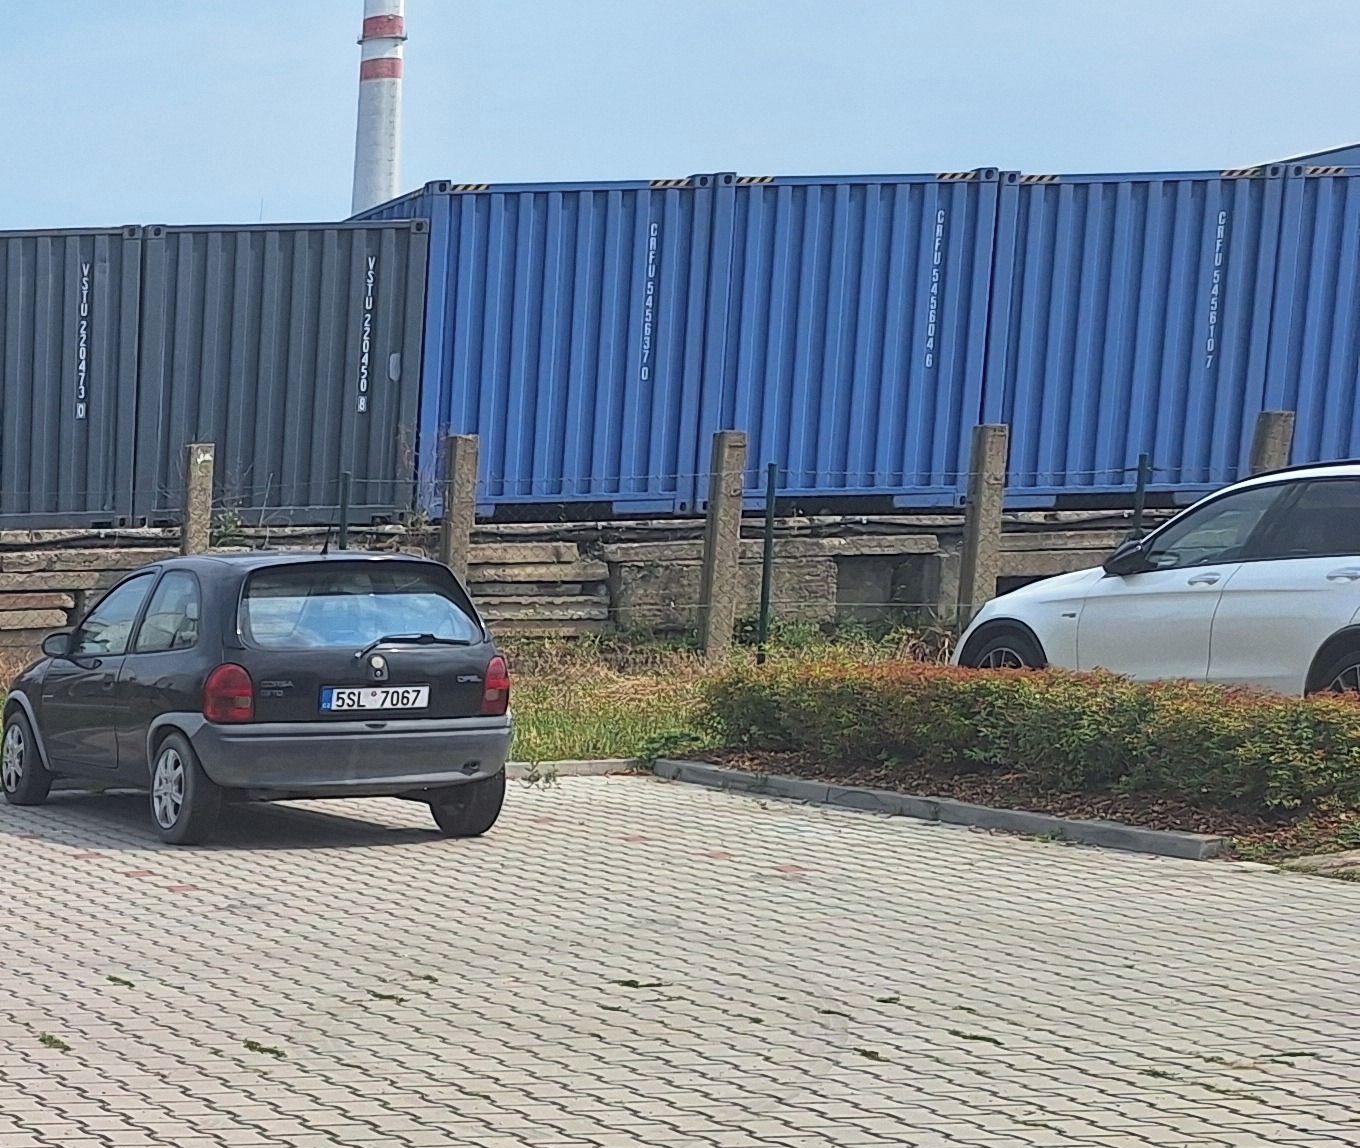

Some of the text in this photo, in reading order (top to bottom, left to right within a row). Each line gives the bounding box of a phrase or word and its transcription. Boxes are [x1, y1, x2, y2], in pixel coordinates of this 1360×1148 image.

[80, 263, 90, 317] VSTU
[365, 256, 376, 310] VSTU
[78, 320, 87, 399] 220473
[360, 313, 372, 392] 220450
[335, 689, 422, 708] 5SL 7067
